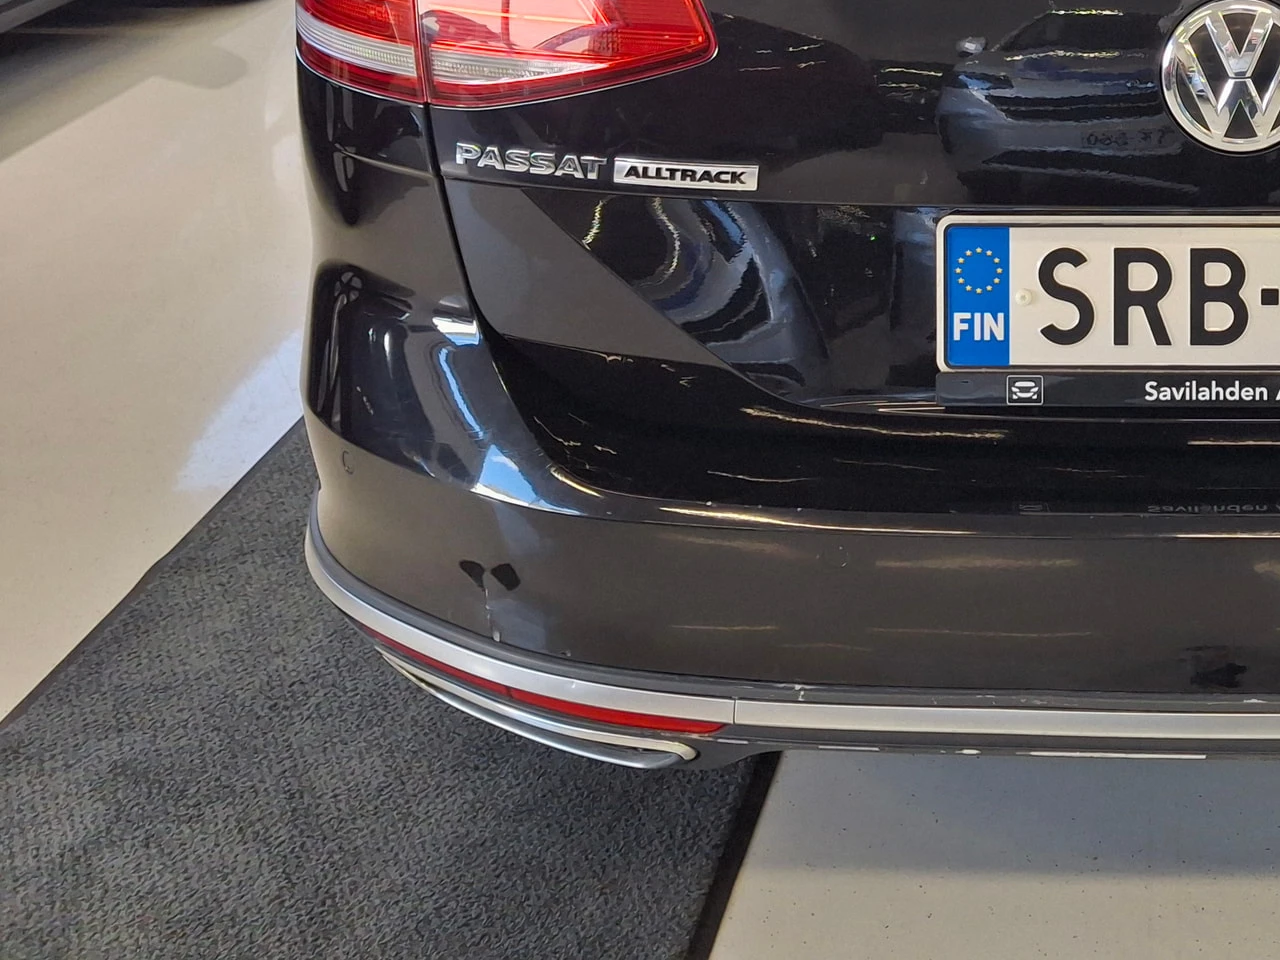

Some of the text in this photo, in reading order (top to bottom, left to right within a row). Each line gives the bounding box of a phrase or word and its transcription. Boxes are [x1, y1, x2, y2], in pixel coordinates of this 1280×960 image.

[455, 141, 747, 185] PASSAT ALLTRACK
[953, 312, 1005, 342] FIN
[1144, 380, 1268, 401] Savilahden
